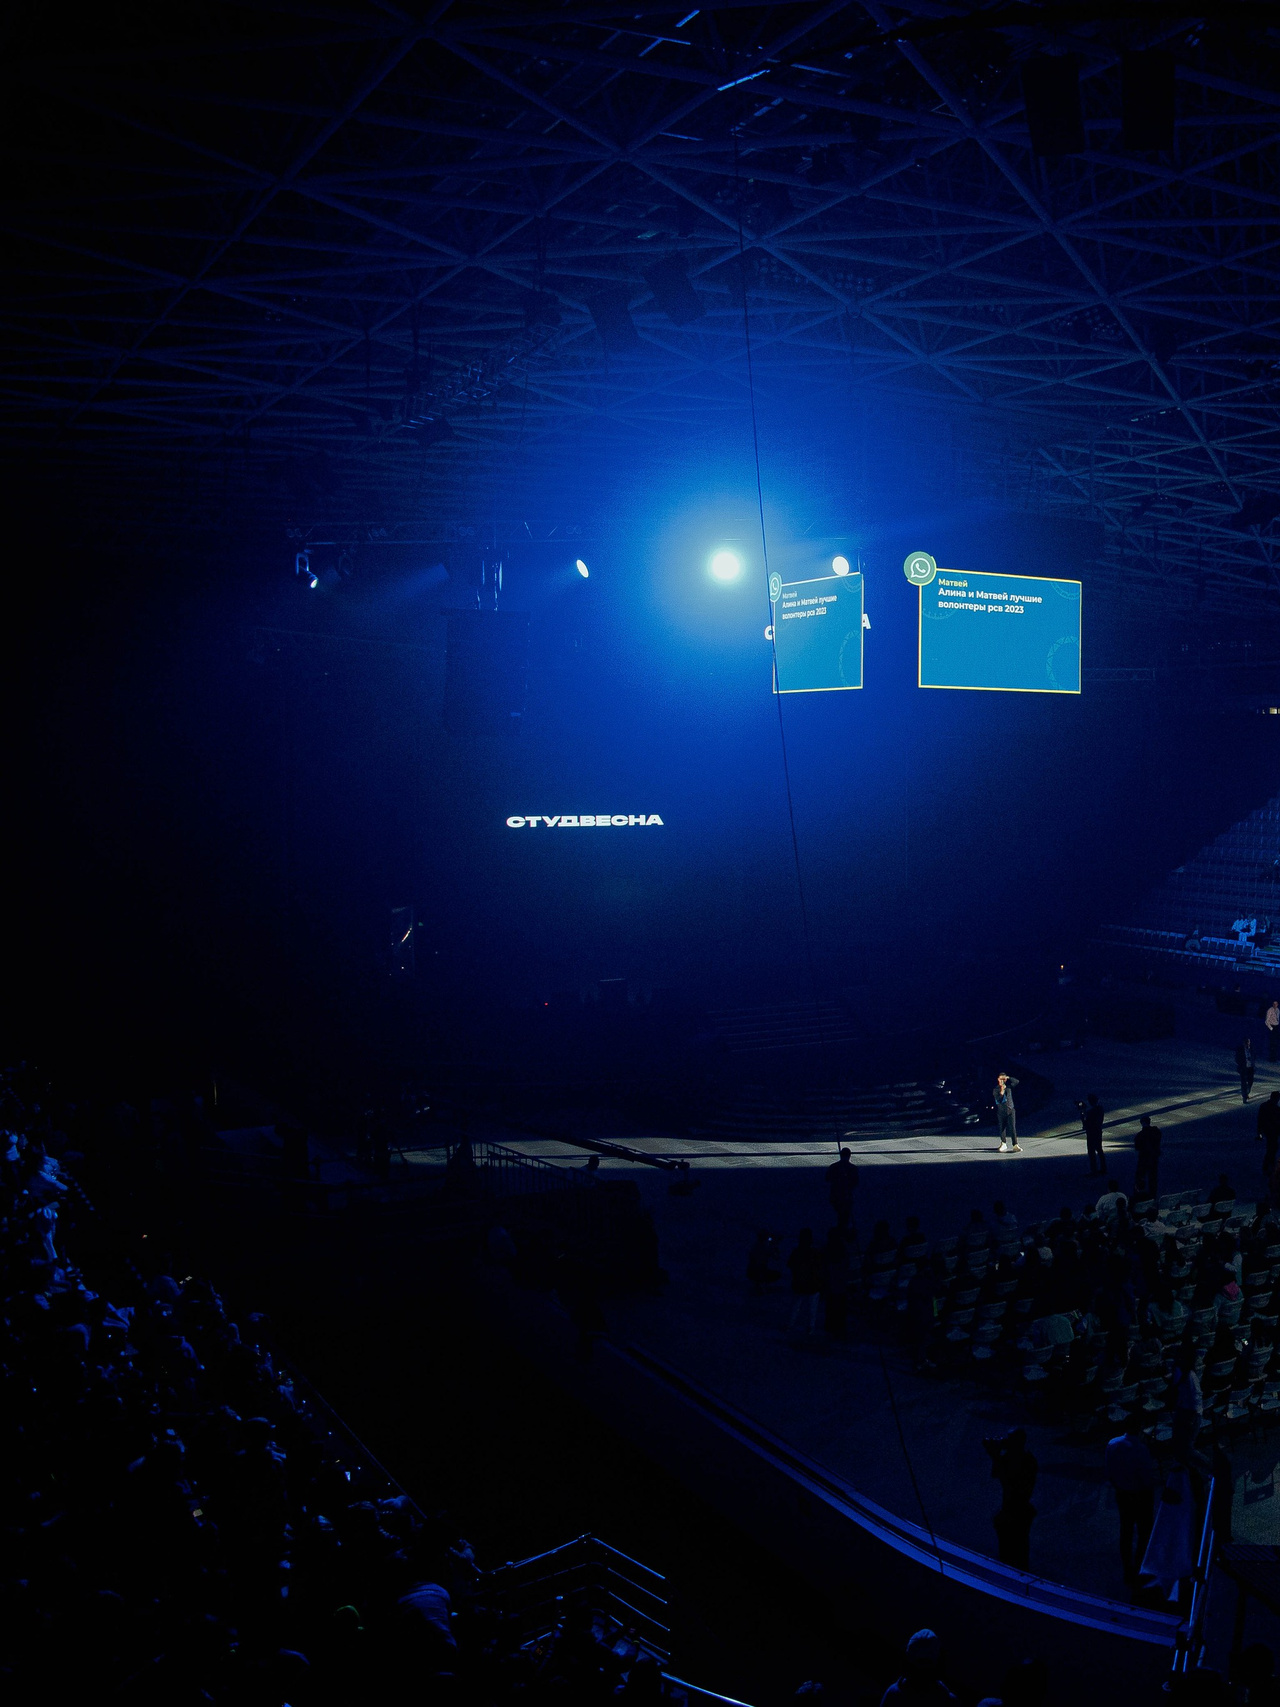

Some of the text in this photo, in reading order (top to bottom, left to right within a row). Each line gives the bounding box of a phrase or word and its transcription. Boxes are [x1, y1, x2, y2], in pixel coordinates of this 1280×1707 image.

[938, 578, 968, 587] Матвей
[801, 596, 818, 606] Матвей
[819, 595, 837, 605] лучшие
[938, 587, 1043, 604] Алина и Матвей лучшие
[782, 611, 806, 620] волонтеры
[816, 606, 827, 615] 2023
[938, 601, 1025, 614] волонтеры рсв 2023
[506, 814, 664, 828] СТУДВЕСНА
